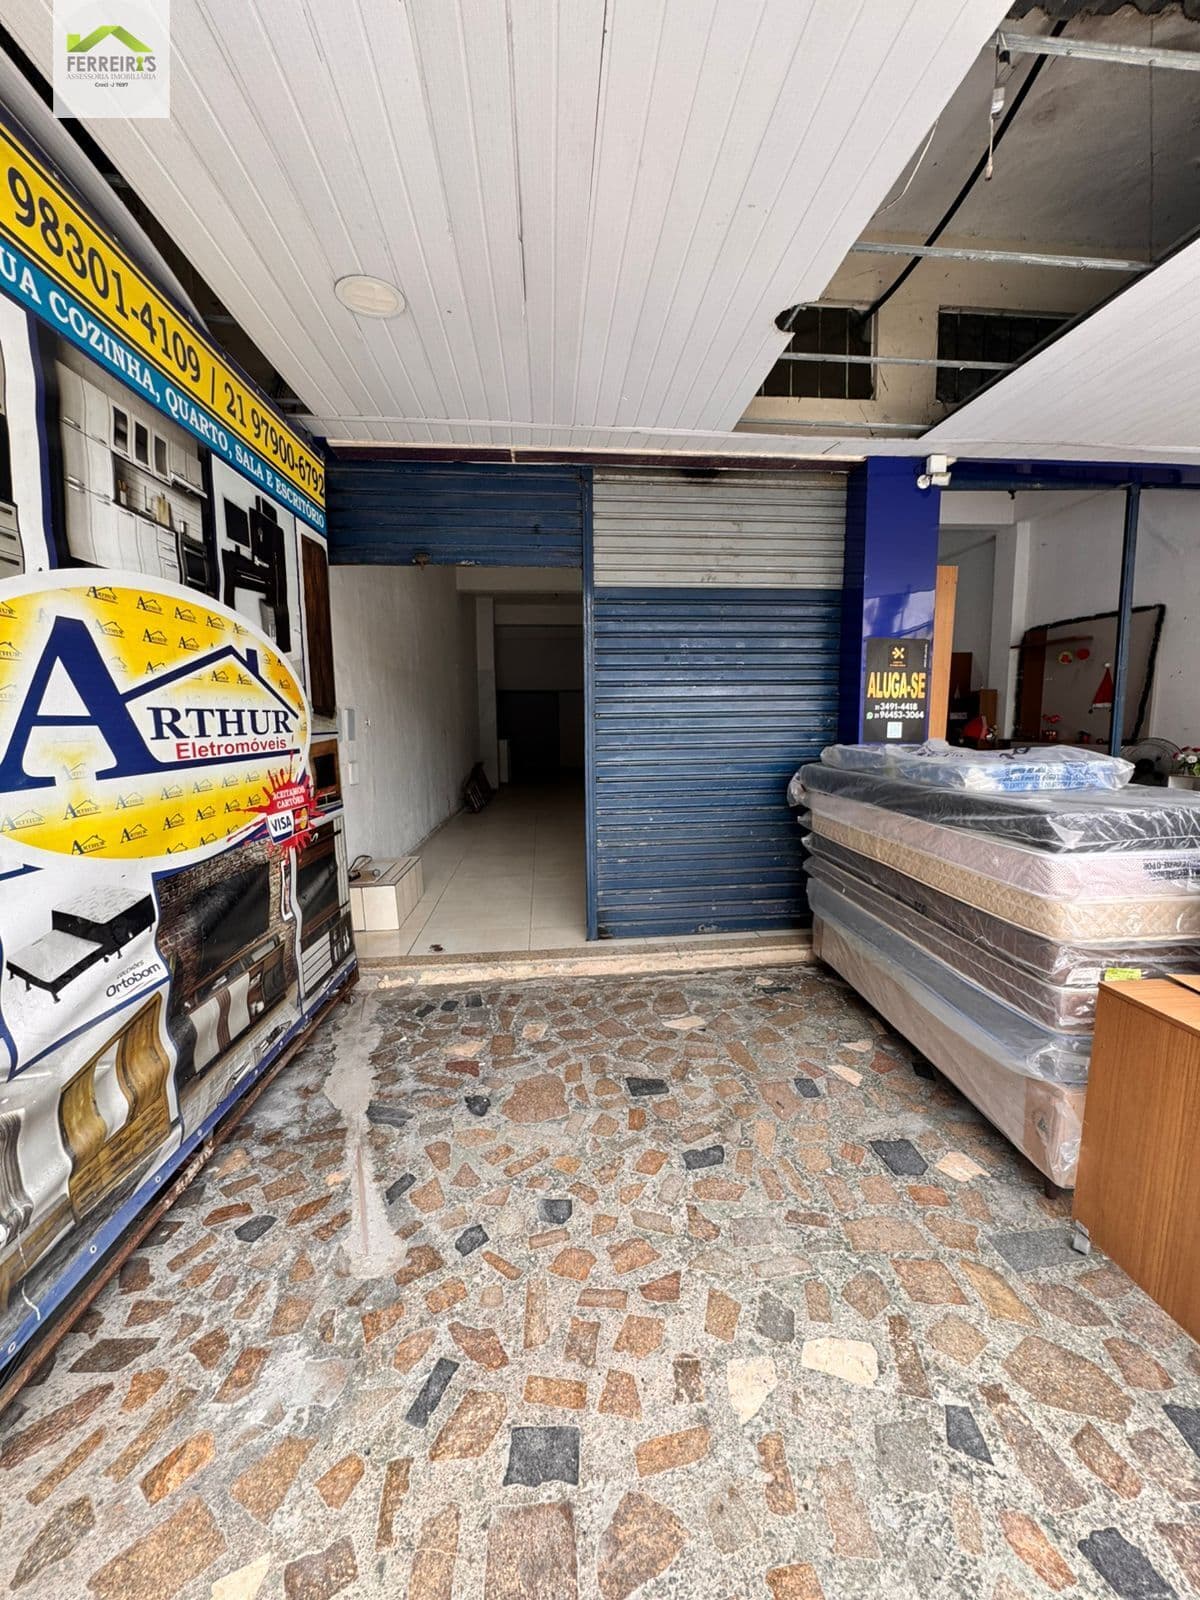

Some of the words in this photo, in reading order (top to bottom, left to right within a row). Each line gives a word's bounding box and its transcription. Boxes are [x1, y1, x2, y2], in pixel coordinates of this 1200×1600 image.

[8, 166, 201, 384] 98301-4109
[224, 382, 247, 429] 21
[250, 407, 325, 498] 97900-6792
[49, 290, 161, 402] COZINHA,
[234, 444, 264, 481] SALA
[264, 473, 274, 489] E
[274, 481, 325, 529] ESCRITÓRIO
[867, 671, 927, 699] ALUGA-SE
[0, 615, 293, 793] ARTHUR
[880, 702, 918, 711] 3491-4418
[880, 710, 925, 719] 96453-3064
[175, 737, 287, 760] Eletromóveis
[271, 815, 292, 832] VISA
[105, 963, 161, 998] Ortobom
